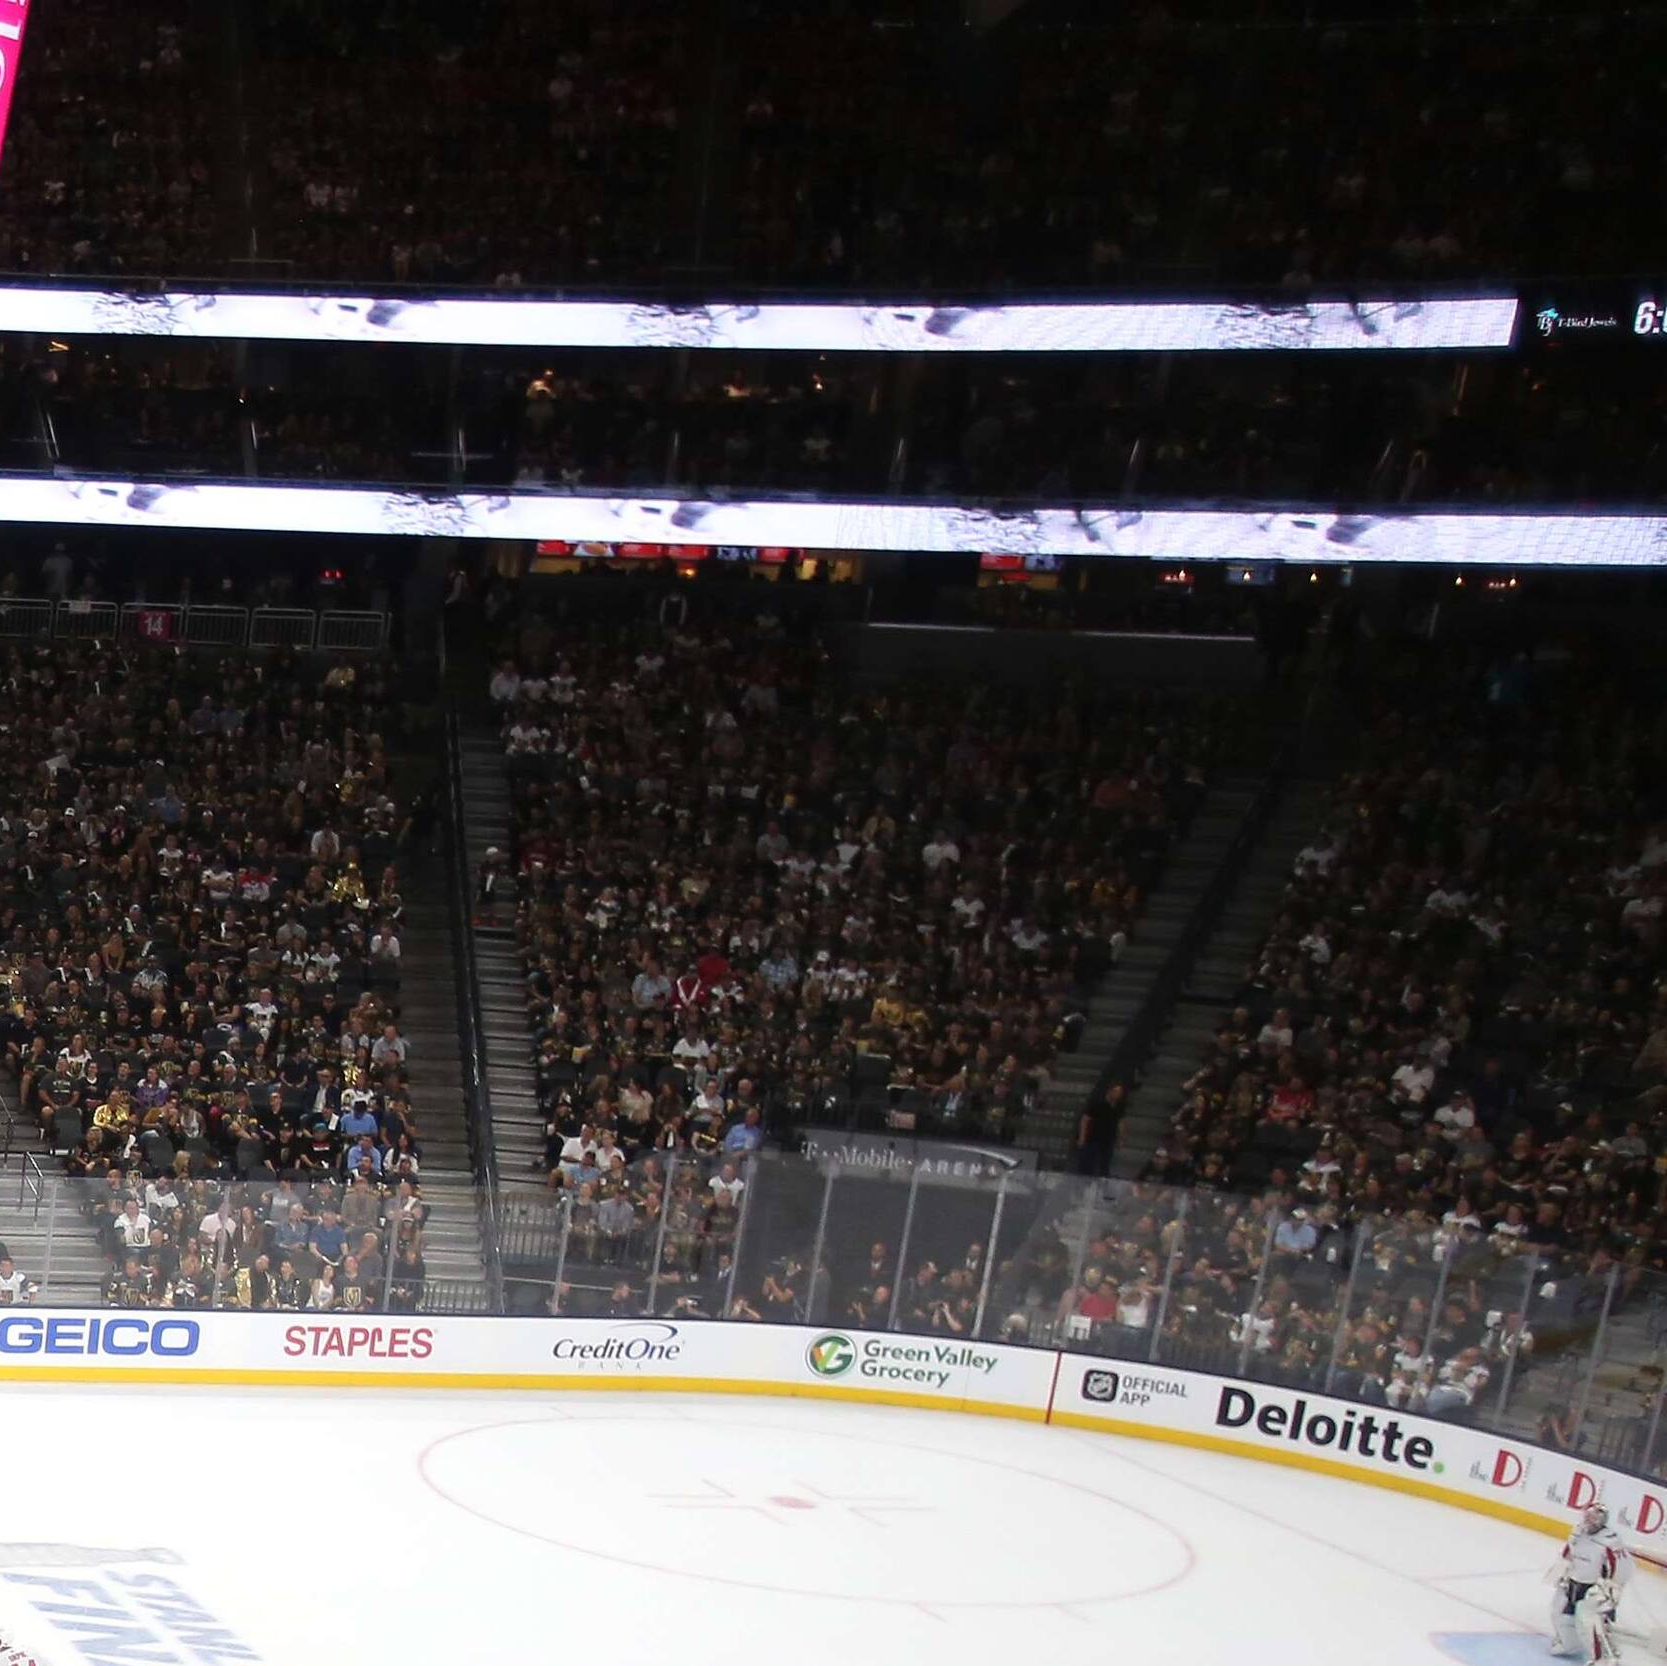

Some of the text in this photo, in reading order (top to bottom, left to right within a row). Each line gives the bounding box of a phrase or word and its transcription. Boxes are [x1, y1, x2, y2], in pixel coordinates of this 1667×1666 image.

[1634, 302, 1667, 335] 6:
[283, 1326, 433, 1358] STAPLES
[863, 1341, 998, 1374] Green Valley
[860, 1361, 951, 1389] Grocery
[1122, 1375, 1187, 1399] OFFICIAL
[1118, 1391, 1150, 1407] APP
